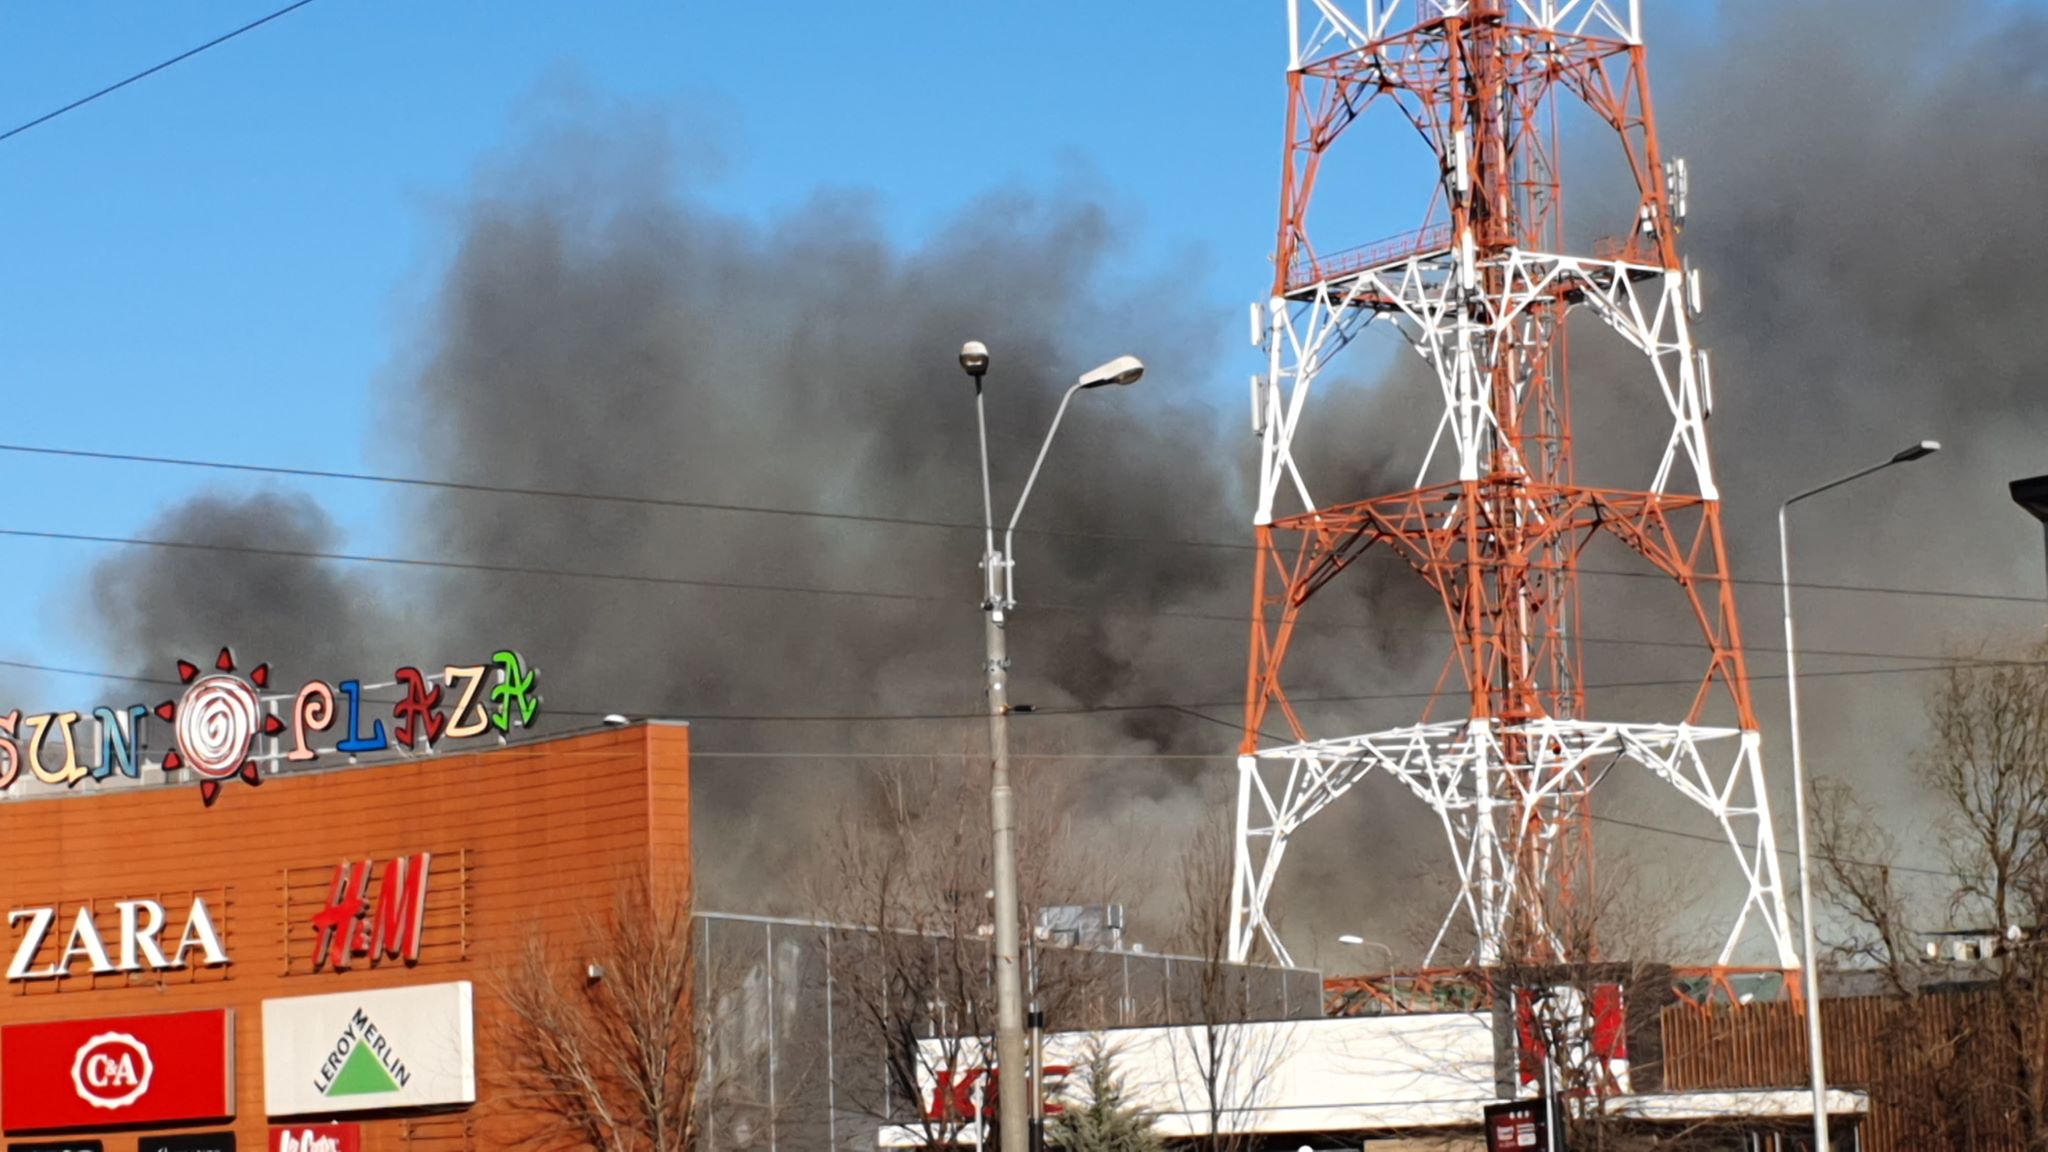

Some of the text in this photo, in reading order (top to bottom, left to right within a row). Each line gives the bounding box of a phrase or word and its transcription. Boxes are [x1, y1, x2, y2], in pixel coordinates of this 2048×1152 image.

[287, 650, 539, 762] PLAZA
[6, 897, 231, 980] ZARA
[311, 852, 430, 970] H&M
[86, 1052, 139, 1087] C&A
[313, 1006, 412, 1094] LEROY MERLIN
[927, 1064, 1074, 1119] KC
